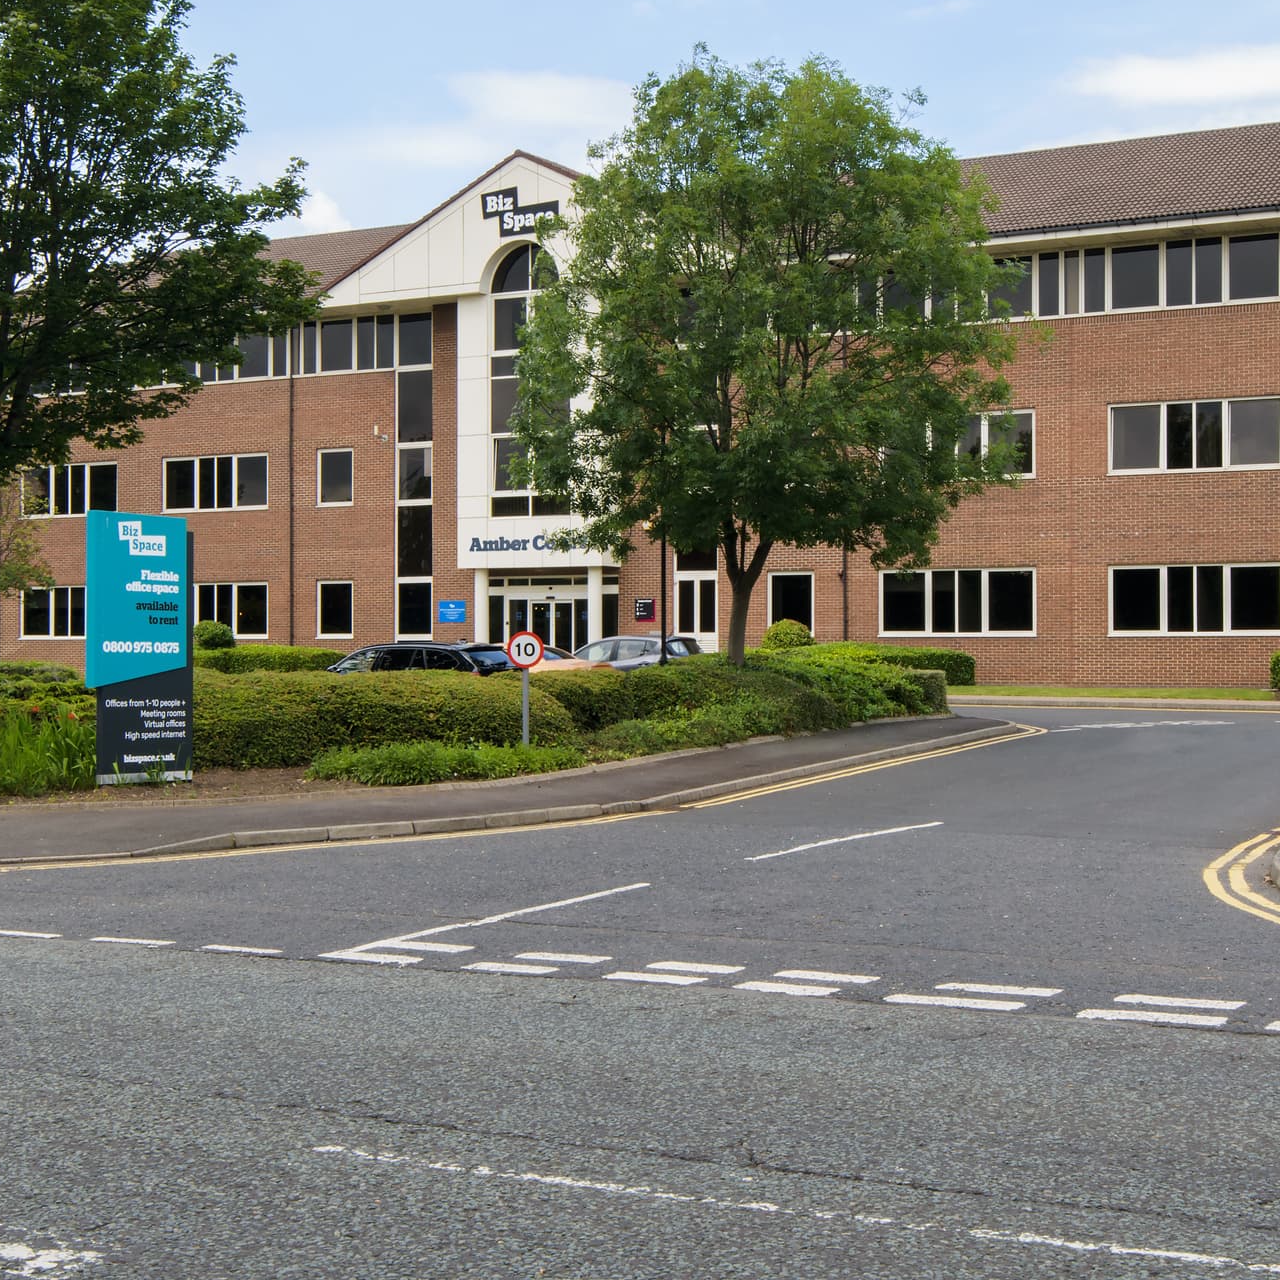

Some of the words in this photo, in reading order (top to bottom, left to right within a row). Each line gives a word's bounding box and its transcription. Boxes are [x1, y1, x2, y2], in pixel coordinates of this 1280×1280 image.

[485, 194, 514, 213] Biz
[122, 525, 139, 537] Biz
[132, 538, 164, 552] Space
[469, 536, 530, 552] Amber
[141, 569, 180, 582] Flexible
[125, 581, 152, 592] office
[152, 584, 180, 595] space
[136, 601, 179, 612] available
[148, 615, 158, 624] to
[159, 616, 179, 625] rent
[102, 640, 133, 653] 0800
[133, 641, 153, 653] 975
[153, 642, 180, 654] 0875
[515, 642, 535, 657] 10
[105, 699, 128, 707] Offices
[129, 699, 145, 707] from
[146, 699, 159, 707] 1-10
[160, 699, 181, 708] people
[140, 709, 166, 719] Meeting
[144, 720, 165, 728] Virtual
[165, 719, 186, 727] offices
[124, 731, 140, 741] High
[141, 731, 161, 740] speed
[161, 730, 186, 738] internet
